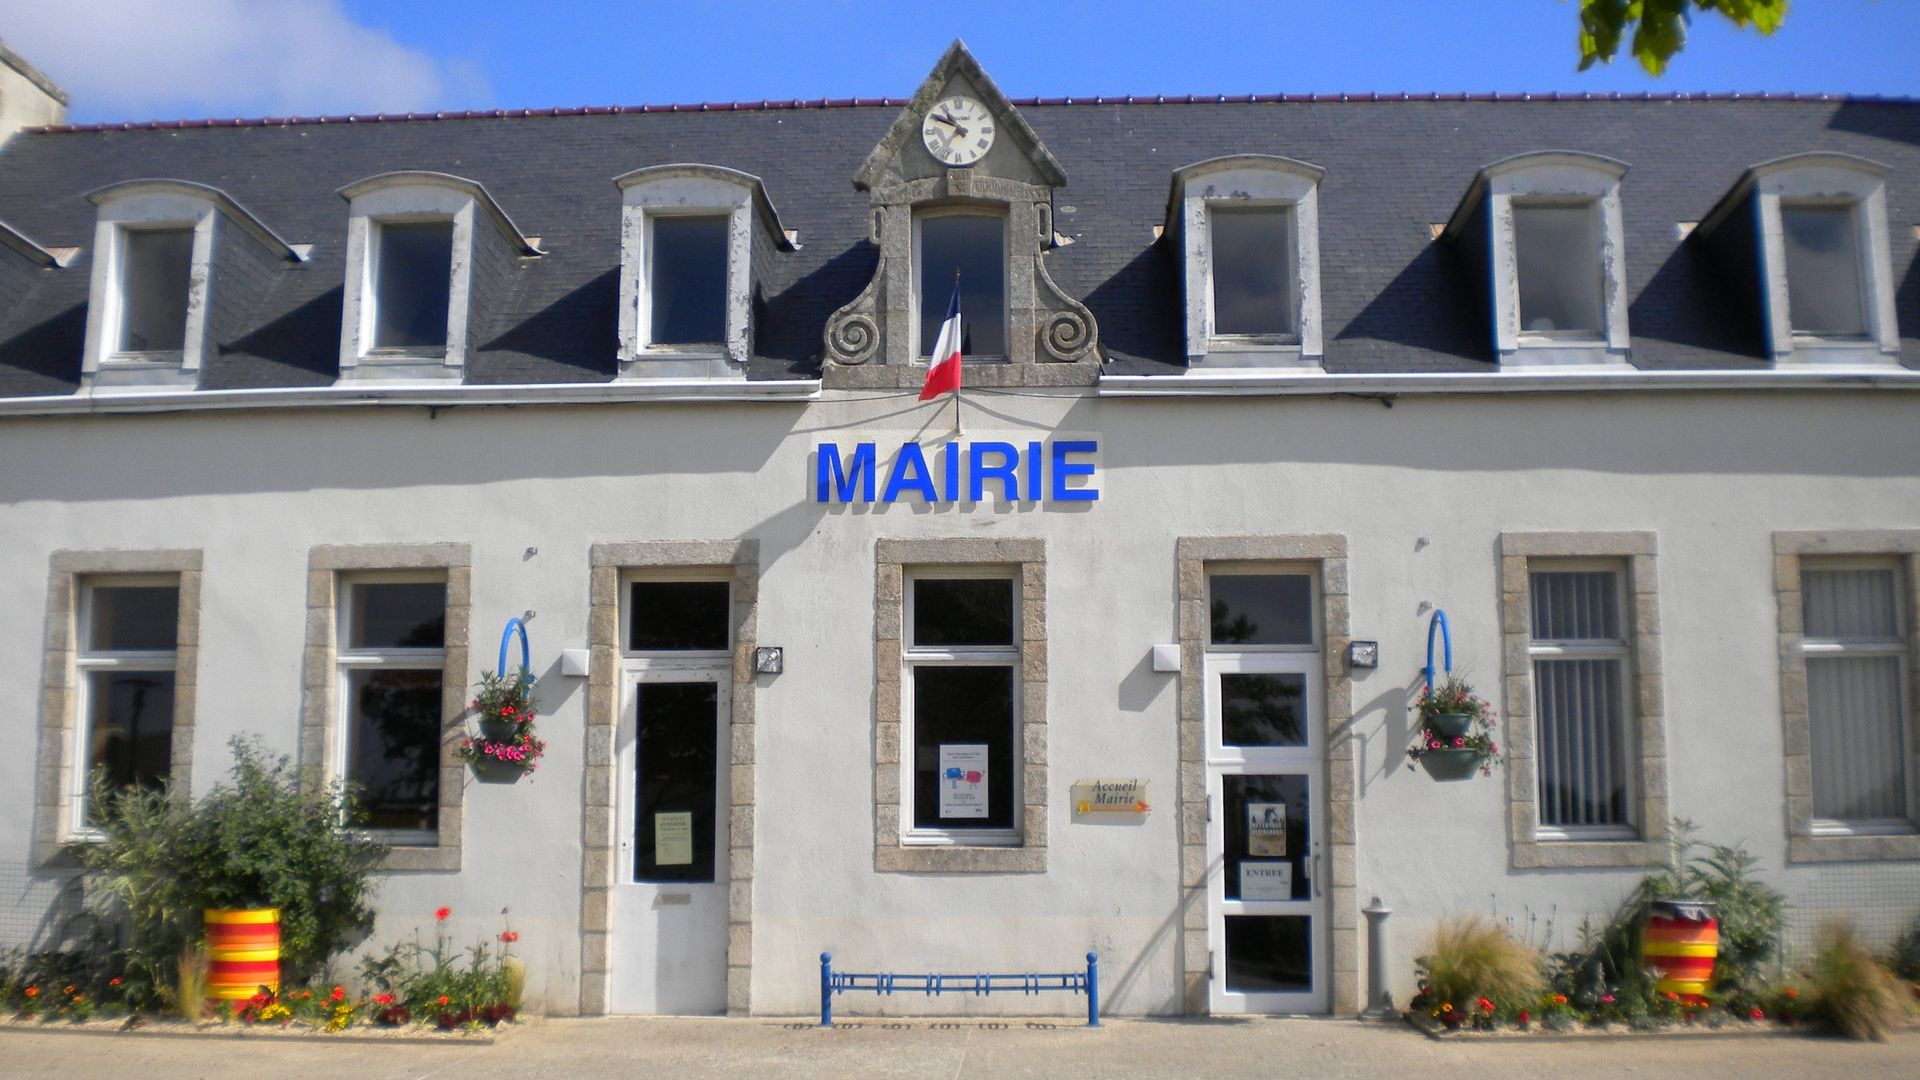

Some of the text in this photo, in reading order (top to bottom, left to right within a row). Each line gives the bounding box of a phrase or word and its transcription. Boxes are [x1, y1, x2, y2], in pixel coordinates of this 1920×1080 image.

[816, 441, 1099, 502] MAIRIE
[1092, 779, 1138, 792] Accueil
[1094, 792, 1136, 805] Mairie
